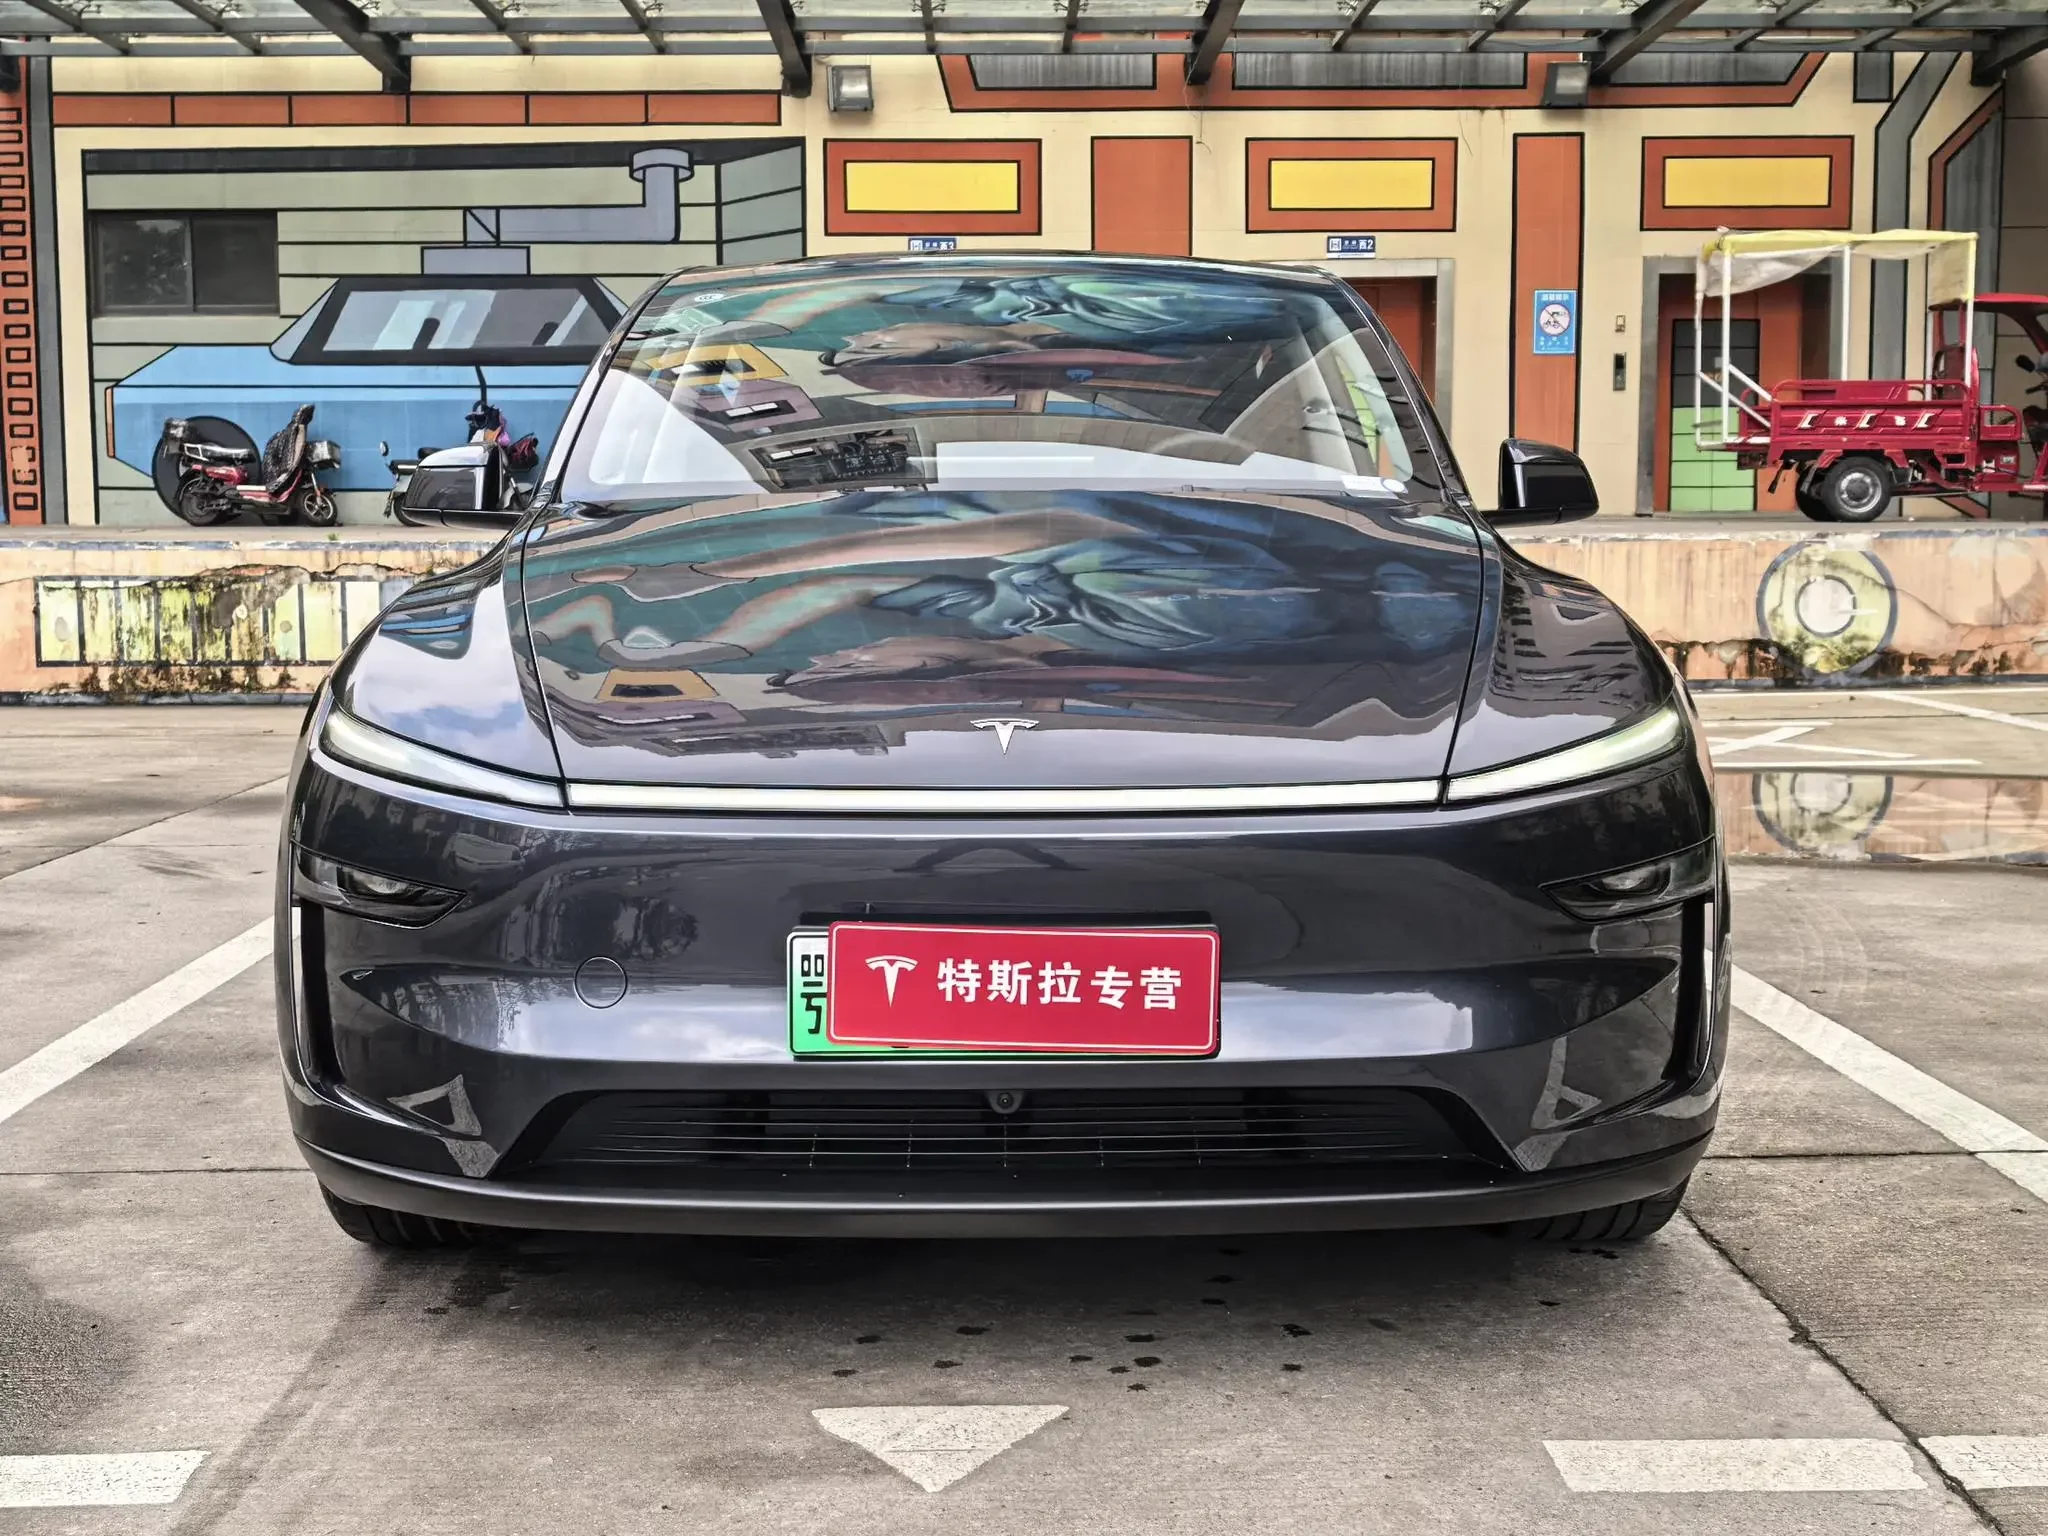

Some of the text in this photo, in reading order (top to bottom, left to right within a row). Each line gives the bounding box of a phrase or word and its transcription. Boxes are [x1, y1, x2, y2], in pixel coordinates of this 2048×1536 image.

[936, 957, 1182, 1010] 特斯拉专营
